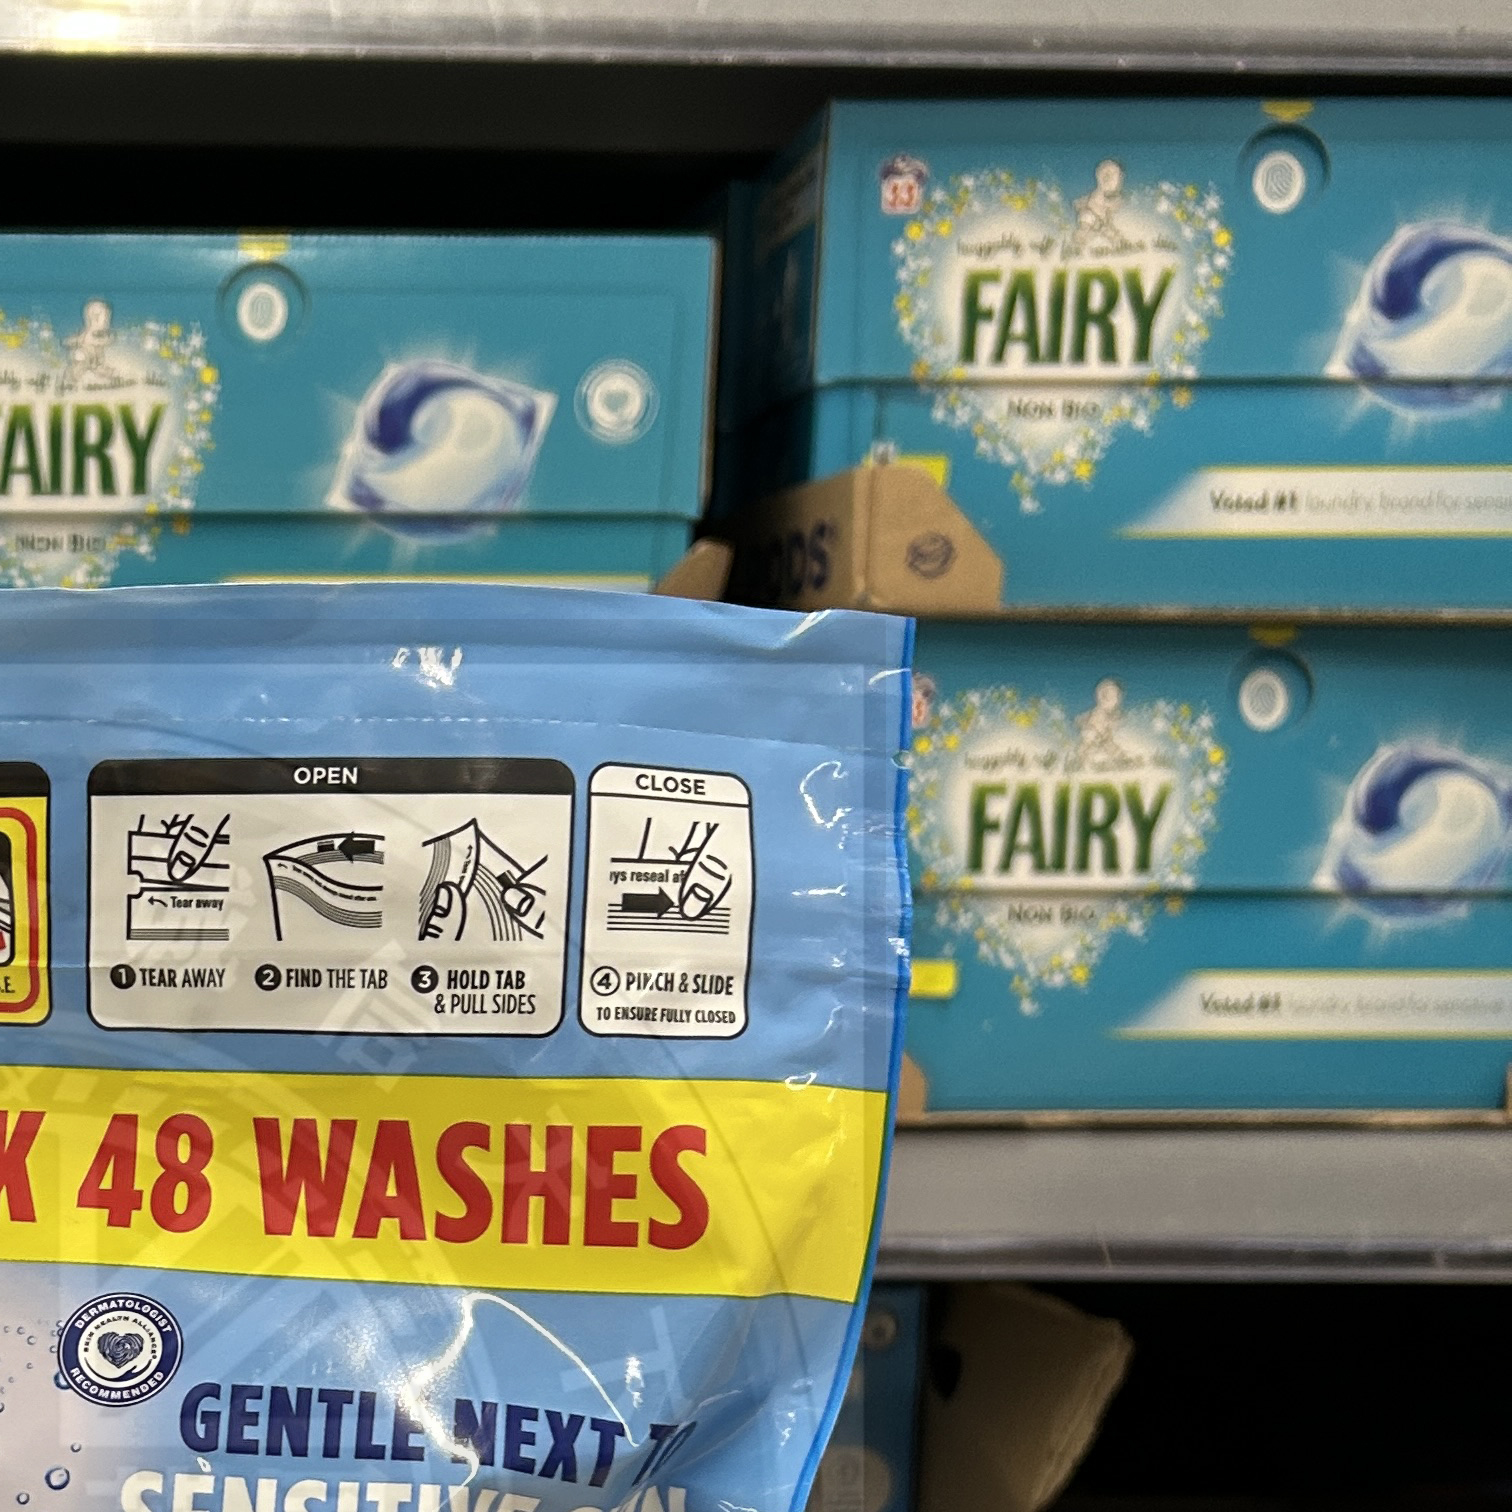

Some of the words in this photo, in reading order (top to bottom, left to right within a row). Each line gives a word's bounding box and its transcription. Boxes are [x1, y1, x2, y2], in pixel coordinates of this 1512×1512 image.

[960, 267, 1175, 365] FAIRY
[292, 766, 359, 786] OPEN
[635, 773, 707, 796] CLOSE
[966, 781, 1173, 875] FAIRY
[630, 869, 669, 884] reseal
[170, 895, 194, 910] Tear
[195, 897, 225, 912] away
[138, 968, 178, 989] TEAR
[181, 968, 226, 988] AWAY
[286, 968, 323, 989] FIND
[326, 969, 356, 990] THE
[359, 969, 388, 990] TAB
[446, 970, 489, 991] HOLD
[493, 970, 526, 991] TAB
[678, 973, 689, 993] &
[692, 972, 735, 996] SLIDE
[434, 995, 448, 1014] &
[451, 994, 486, 1014] PULL
[489, 995, 537, 1016] SIDES
[596, 1006, 612, 1021] TO
[614, 1006, 659, 1022] ENSURE
[659, 1007, 692, 1024] FULLY
[694, 1009, 737, 1024] CLOSED
[76, 1111, 215, 1234] 48
[253, 1114, 711, 1251] WASHES
[74, 1299, 173, 1334] DERMATOLOGIST
[69, 1366, 165, 1400] RECOMMENDED
[180, 1380, 428, 1464] GENTLE
[454, 1398, 626, 1488] NEXT
